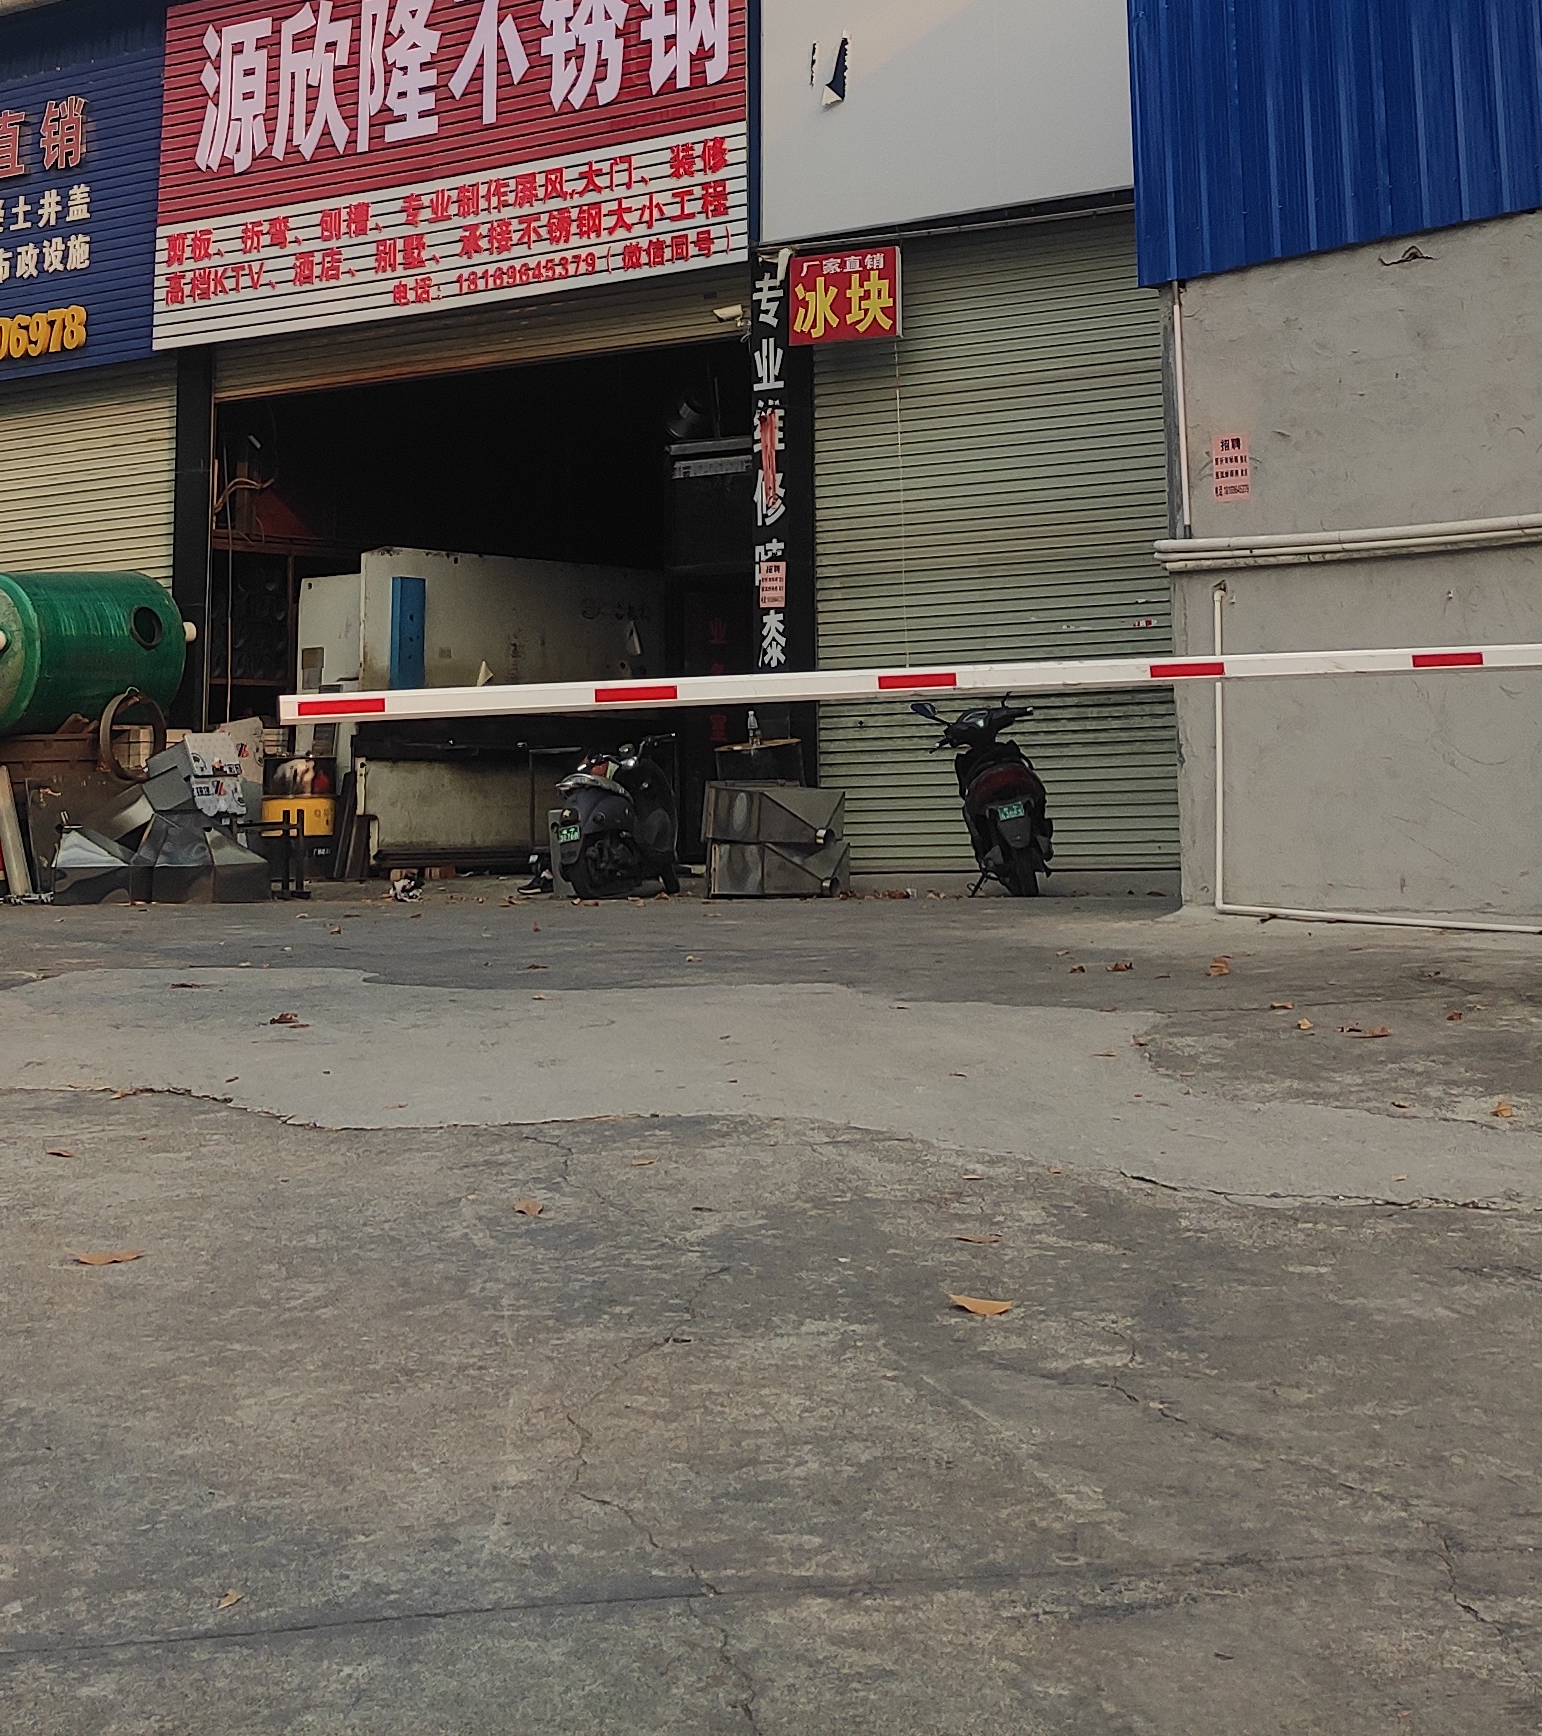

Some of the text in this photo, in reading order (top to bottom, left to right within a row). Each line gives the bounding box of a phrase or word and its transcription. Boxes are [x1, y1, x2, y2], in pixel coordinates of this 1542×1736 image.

[801, 252, 884, 276] 厂家直销
[793, 271, 894, 338] 冰块
